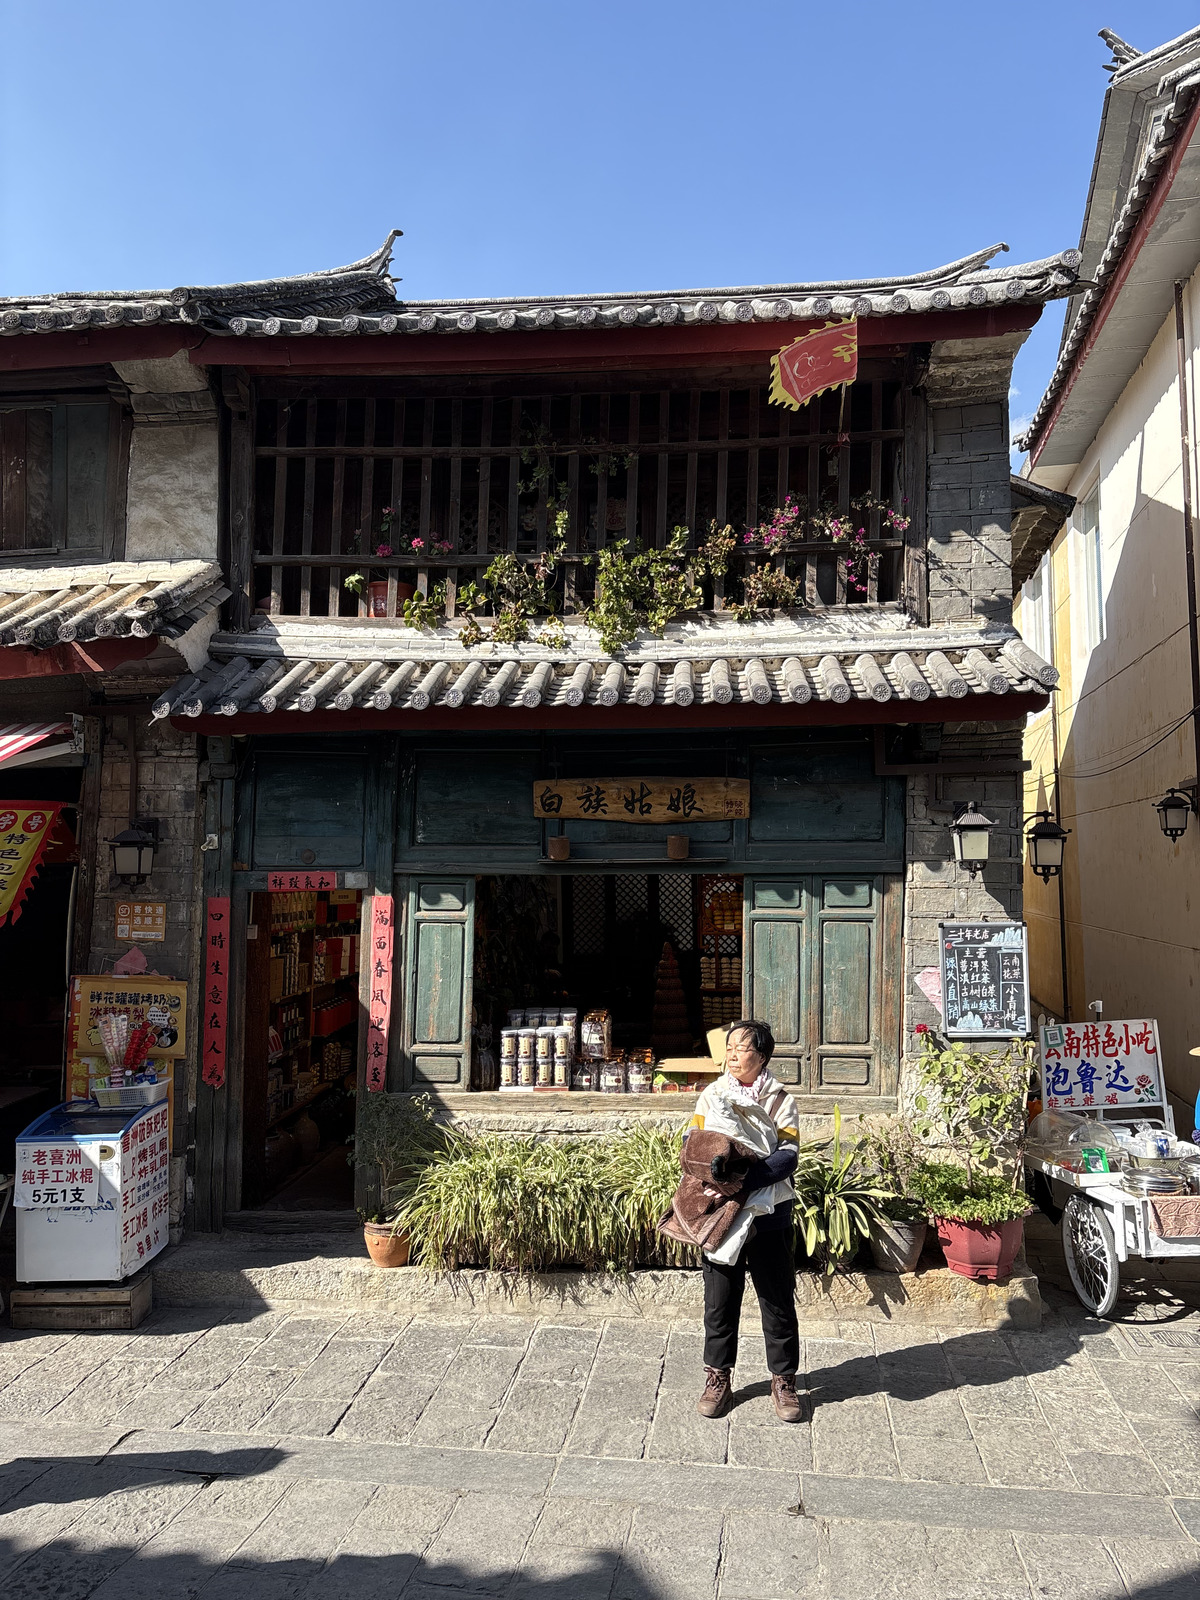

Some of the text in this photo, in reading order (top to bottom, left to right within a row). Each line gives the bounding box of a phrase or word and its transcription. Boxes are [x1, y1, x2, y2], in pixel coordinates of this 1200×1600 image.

[540, 782, 703, 817] 白族姑娘
[948, 928, 990, 940] 二十年老店
[960, 959, 990, 972] 普洱茶
[1003, 954, 1020, 967] 云南
[90, 991, 167, 1006] 鲜花罐罐烤奶
[961, 984, 997, 998] 古树白茶
[962, 998, 998, 1011] 高山绿茶
[1046, 1060, 1134, 1096] 泡鲁达
[32, 1149, 82, 1166] 老喜洲
[137, 1135, 168, 1165] 烤乳扇
[137, 1152, 168, 1182] 炸乳扇
[22, 1168, 93, 1185] 纯手工冰棍
[32, 1187, 85, 1204] 5元1支
